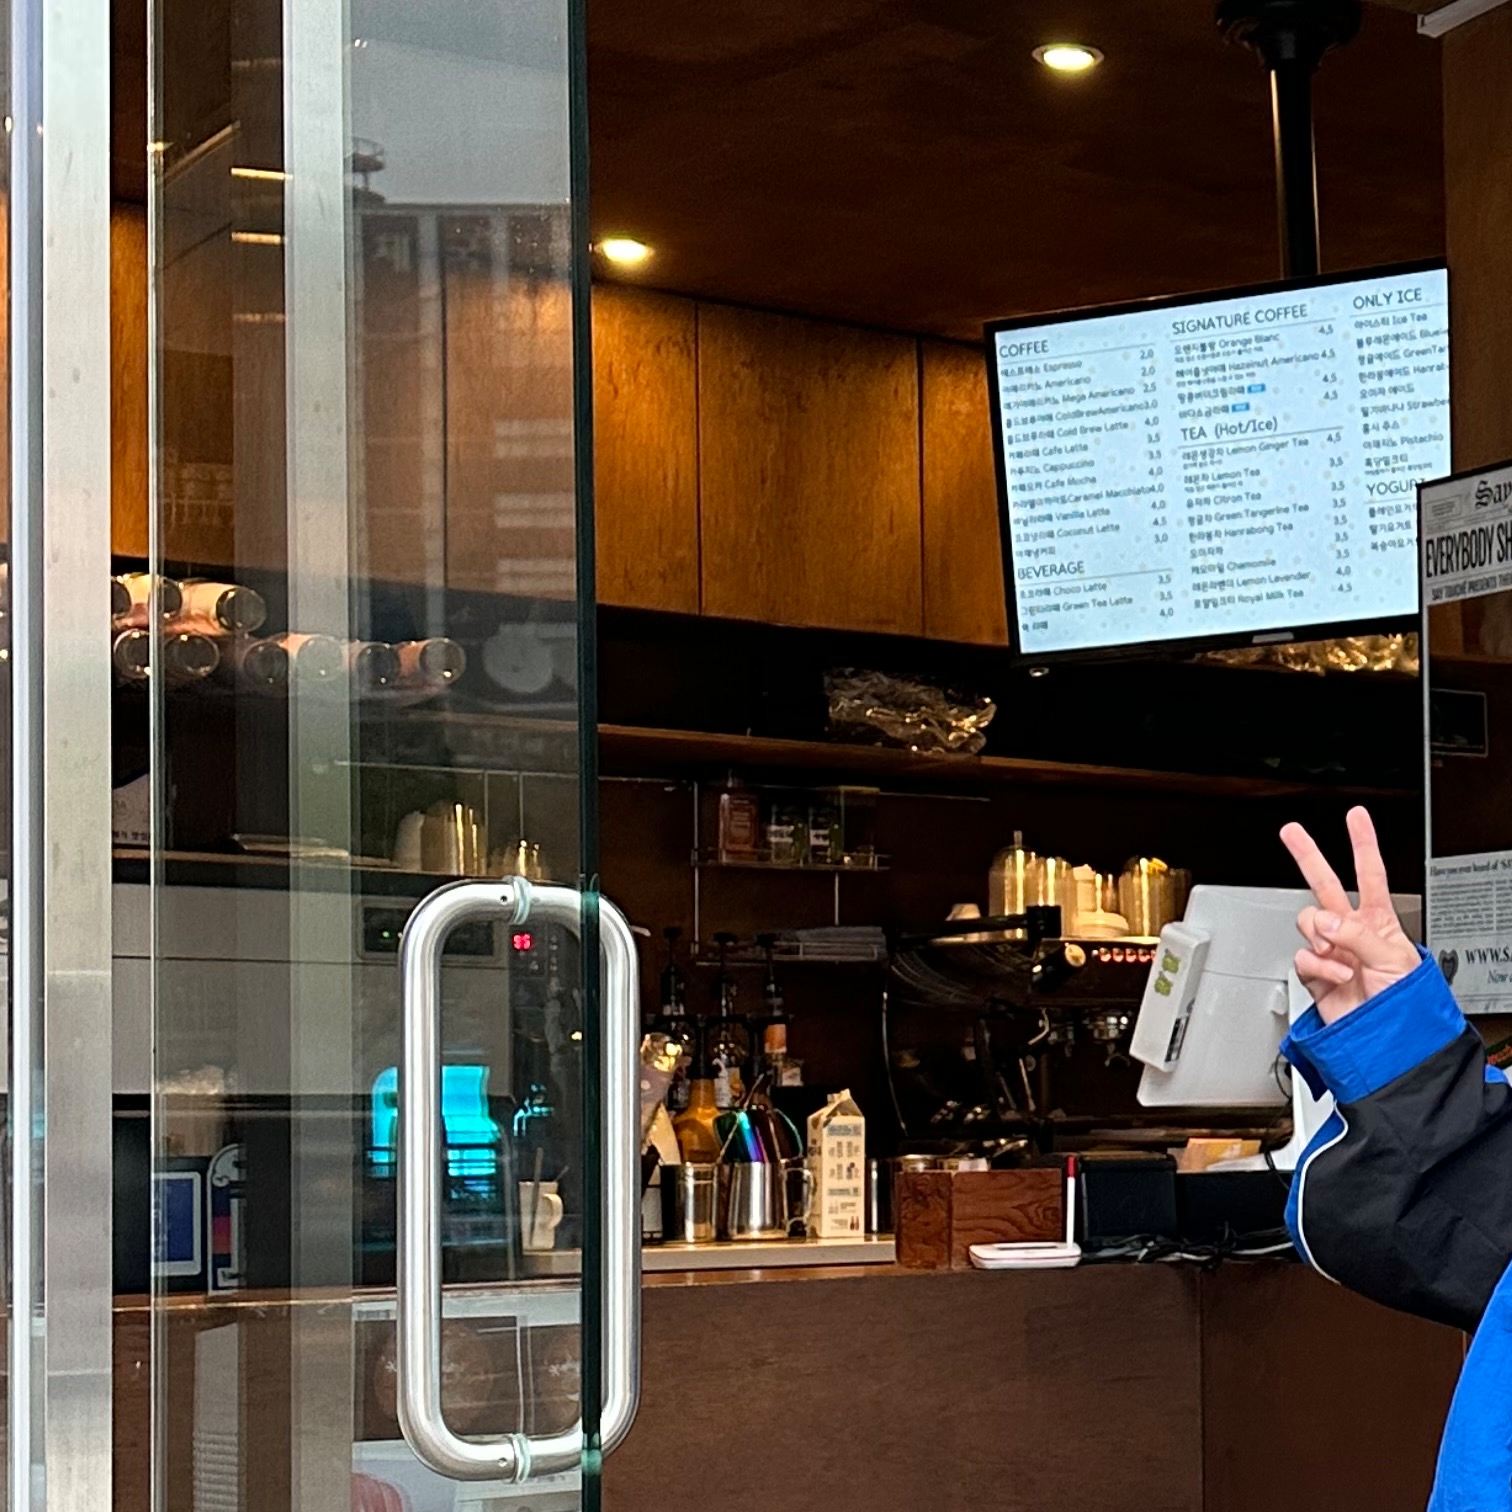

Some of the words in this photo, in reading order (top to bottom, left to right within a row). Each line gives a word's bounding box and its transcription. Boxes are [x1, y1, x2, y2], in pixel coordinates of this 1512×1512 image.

[1352, 292, 1392, 310] ONLY
[1396, 288, 1422, 304] ICE
[1171, 312, 1251, 335] SIGNATURE
[1254, 304, 1308, 324] COFFEE
[1409, 311, 1427, 322] Tea
[998, 339, 1049, 359] COFFEE
[1218, 336, 1253, 351] Orange
[1044, 375, 1091, 389] Americano
[1087, 386, 1136, 400] Americano
[1055, 426, 1078, 438] Cold
[1103, 421, 1128, 432] Latte
[1180, 425, 1207, 442] TEA
[1214, 416, 1278, 439] (Hot/Ice)
[1041, 445, 1063, 456] Cafe
[1064, 443, 1088, 454] Latte
[1225, 443, 1257, 457] Lemon
[1291, 436, 1309, 447] Tea
[1211, 469, 1242, 482] Lemon
[1243, 467, 1261, 478] Tea
[1043, 478, 1065, 489] Cafe
[1244, 491, 1262, 501] Tea
[1474, 479, 1512, 510] Say
[1085, 507, 1111, 518] Latte
[1292, 502, 1309, 513] Tea
[1276, 521, 1293, 532] Tea
[1426, 524, 1494, 578] EVERYBODY
[1016, 560, 1085, 581] BEVERAGE
[1082, 582, 1107, 593] Latte
[1286, 588, 1304, 598] Tea
[1090, 598, 1108, 608] Tea
[1108, 596, 1133, 606] Latte
